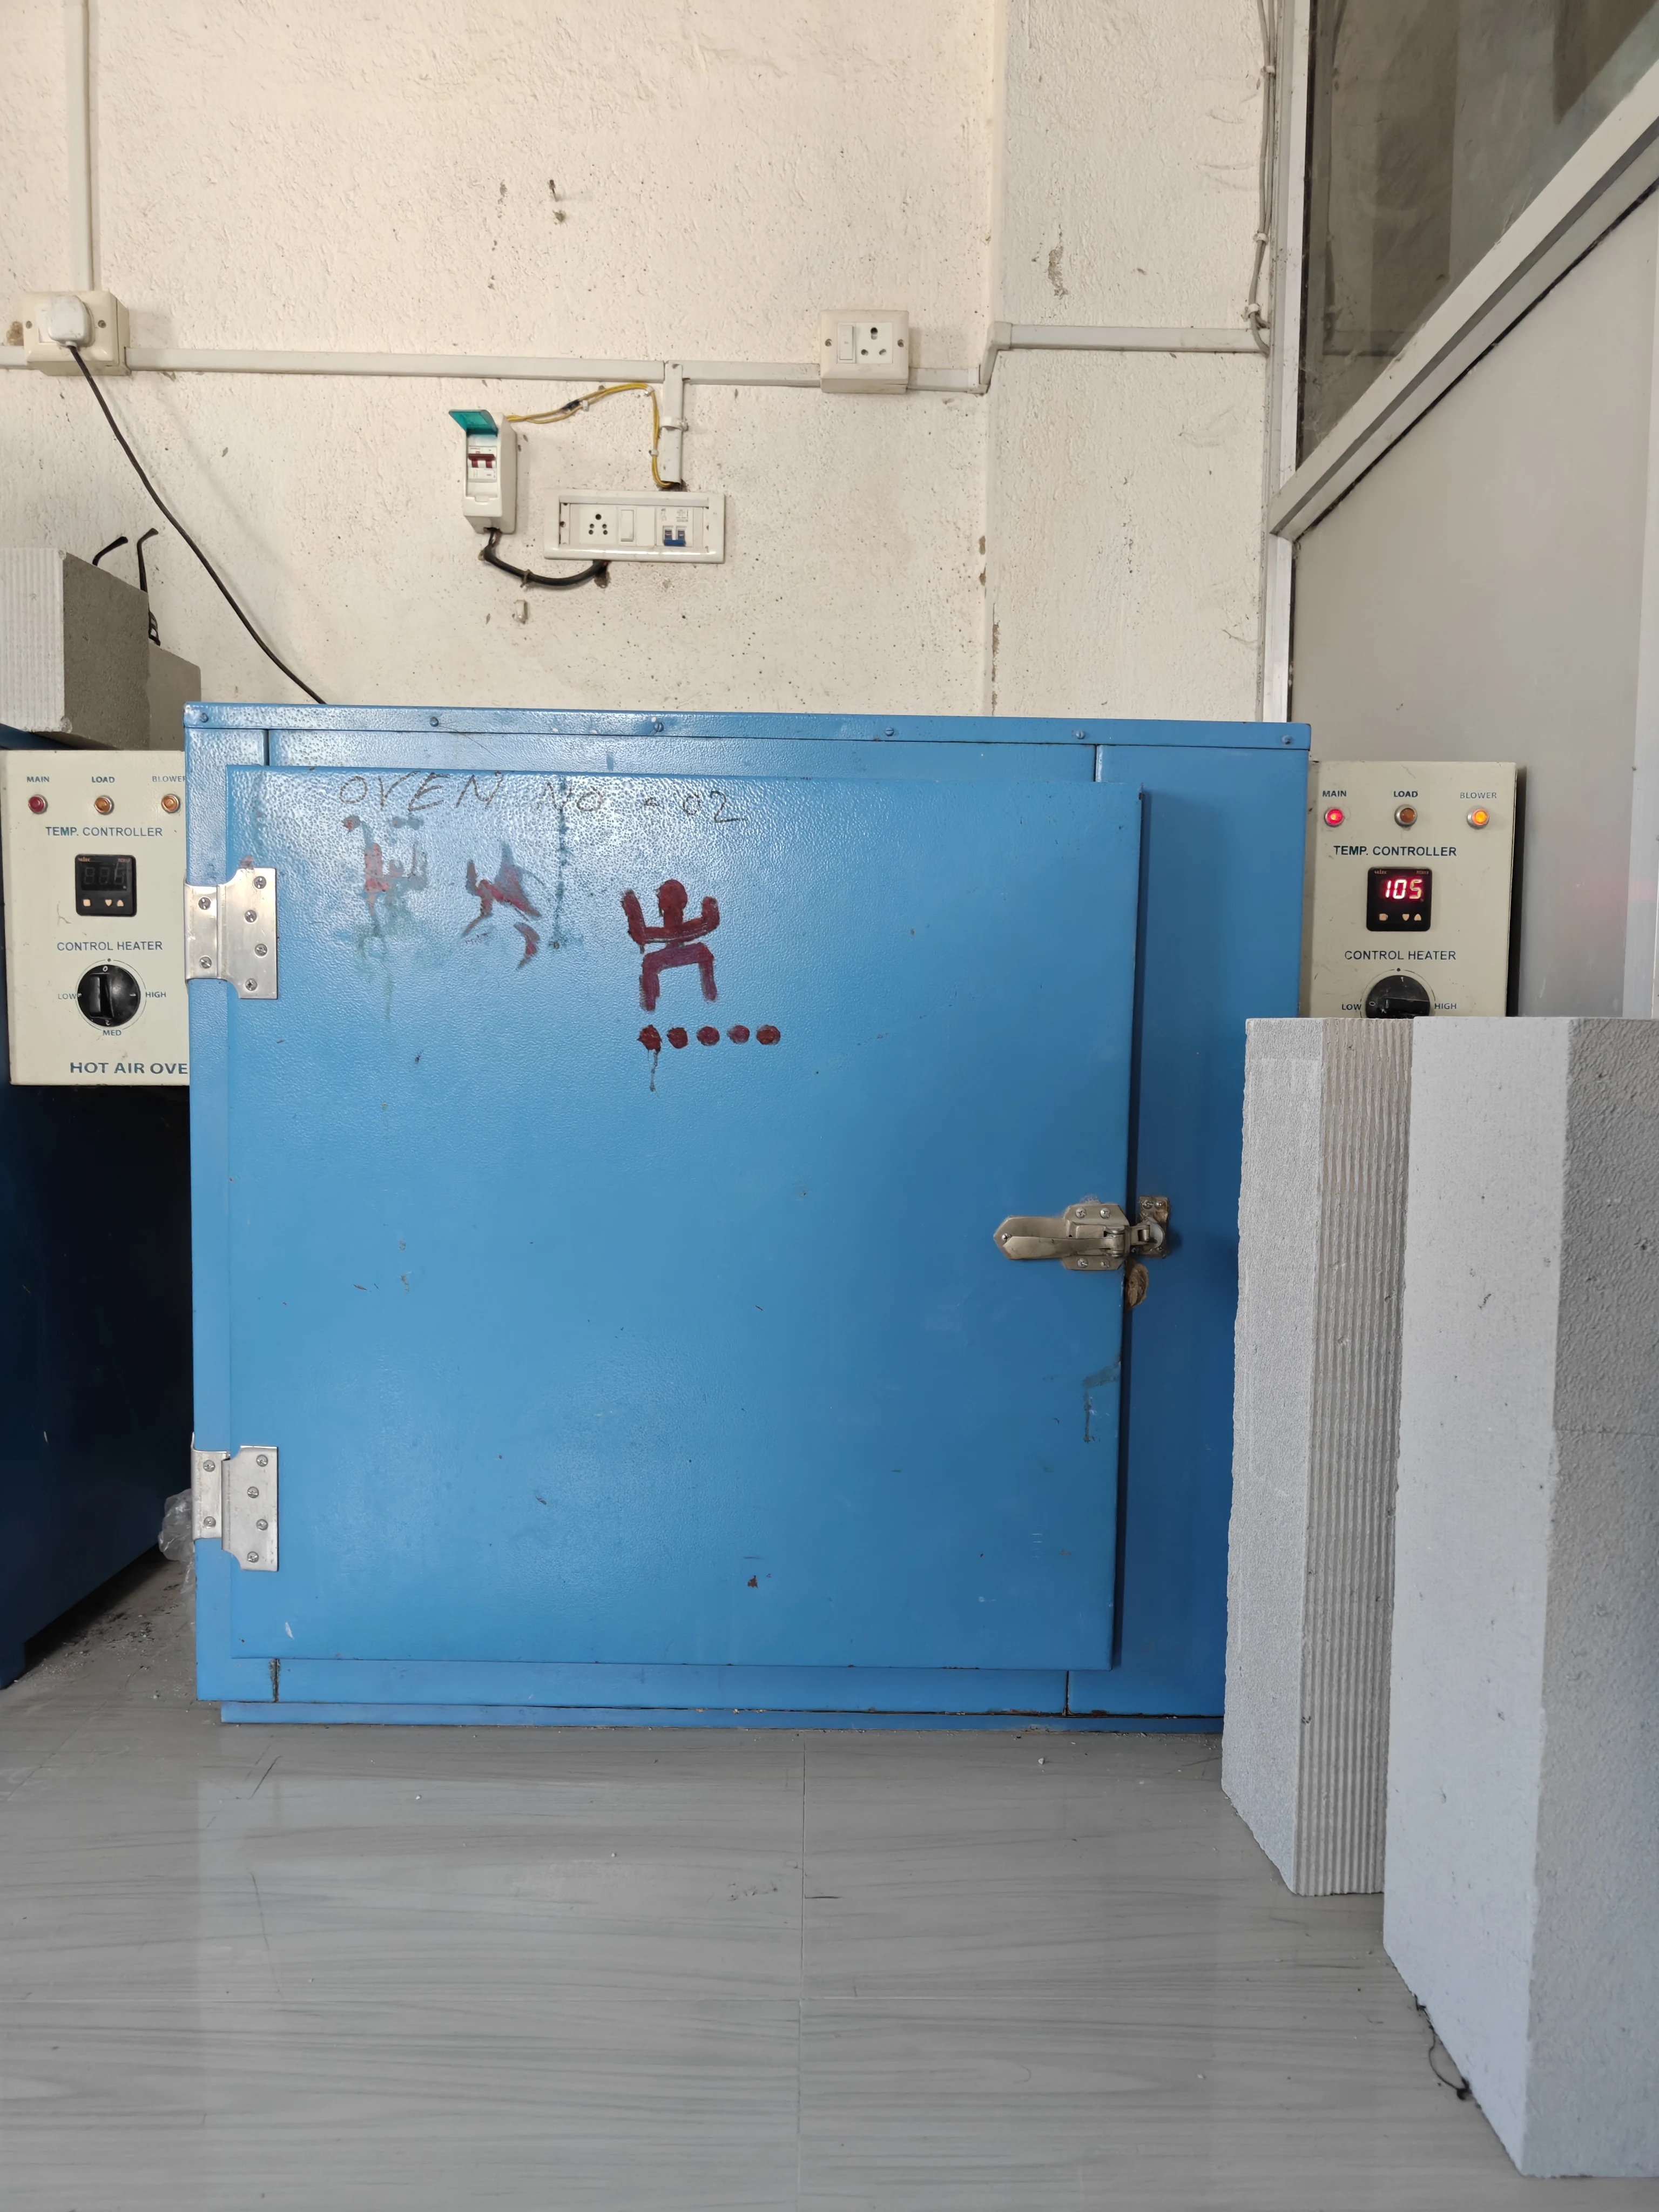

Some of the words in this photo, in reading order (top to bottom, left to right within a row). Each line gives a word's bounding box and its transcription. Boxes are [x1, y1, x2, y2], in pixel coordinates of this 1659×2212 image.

[339, 770, 504, 811] OVEN
[45, 826, 79, 836] TEMP.
[82, 827, 163, 837] CONTROLLER
[1333, 845, 1368, 855] TEMP.
[1372, 846, 1457, 856] CONTROLLER
[1385, 879, 1422, 899] 105
[57, 941, 113, 951] CONTROL
[117, 941, 163, 950] HEATER
[1344, 950, 1404, 960] CONTROL
[1408, 950, 1456, 960] HEATER
[70, 1062, 109, 1074] HOT
[114, 1062, 145, 1074] AIR
[150, 1062, 188, 1074] OVE
